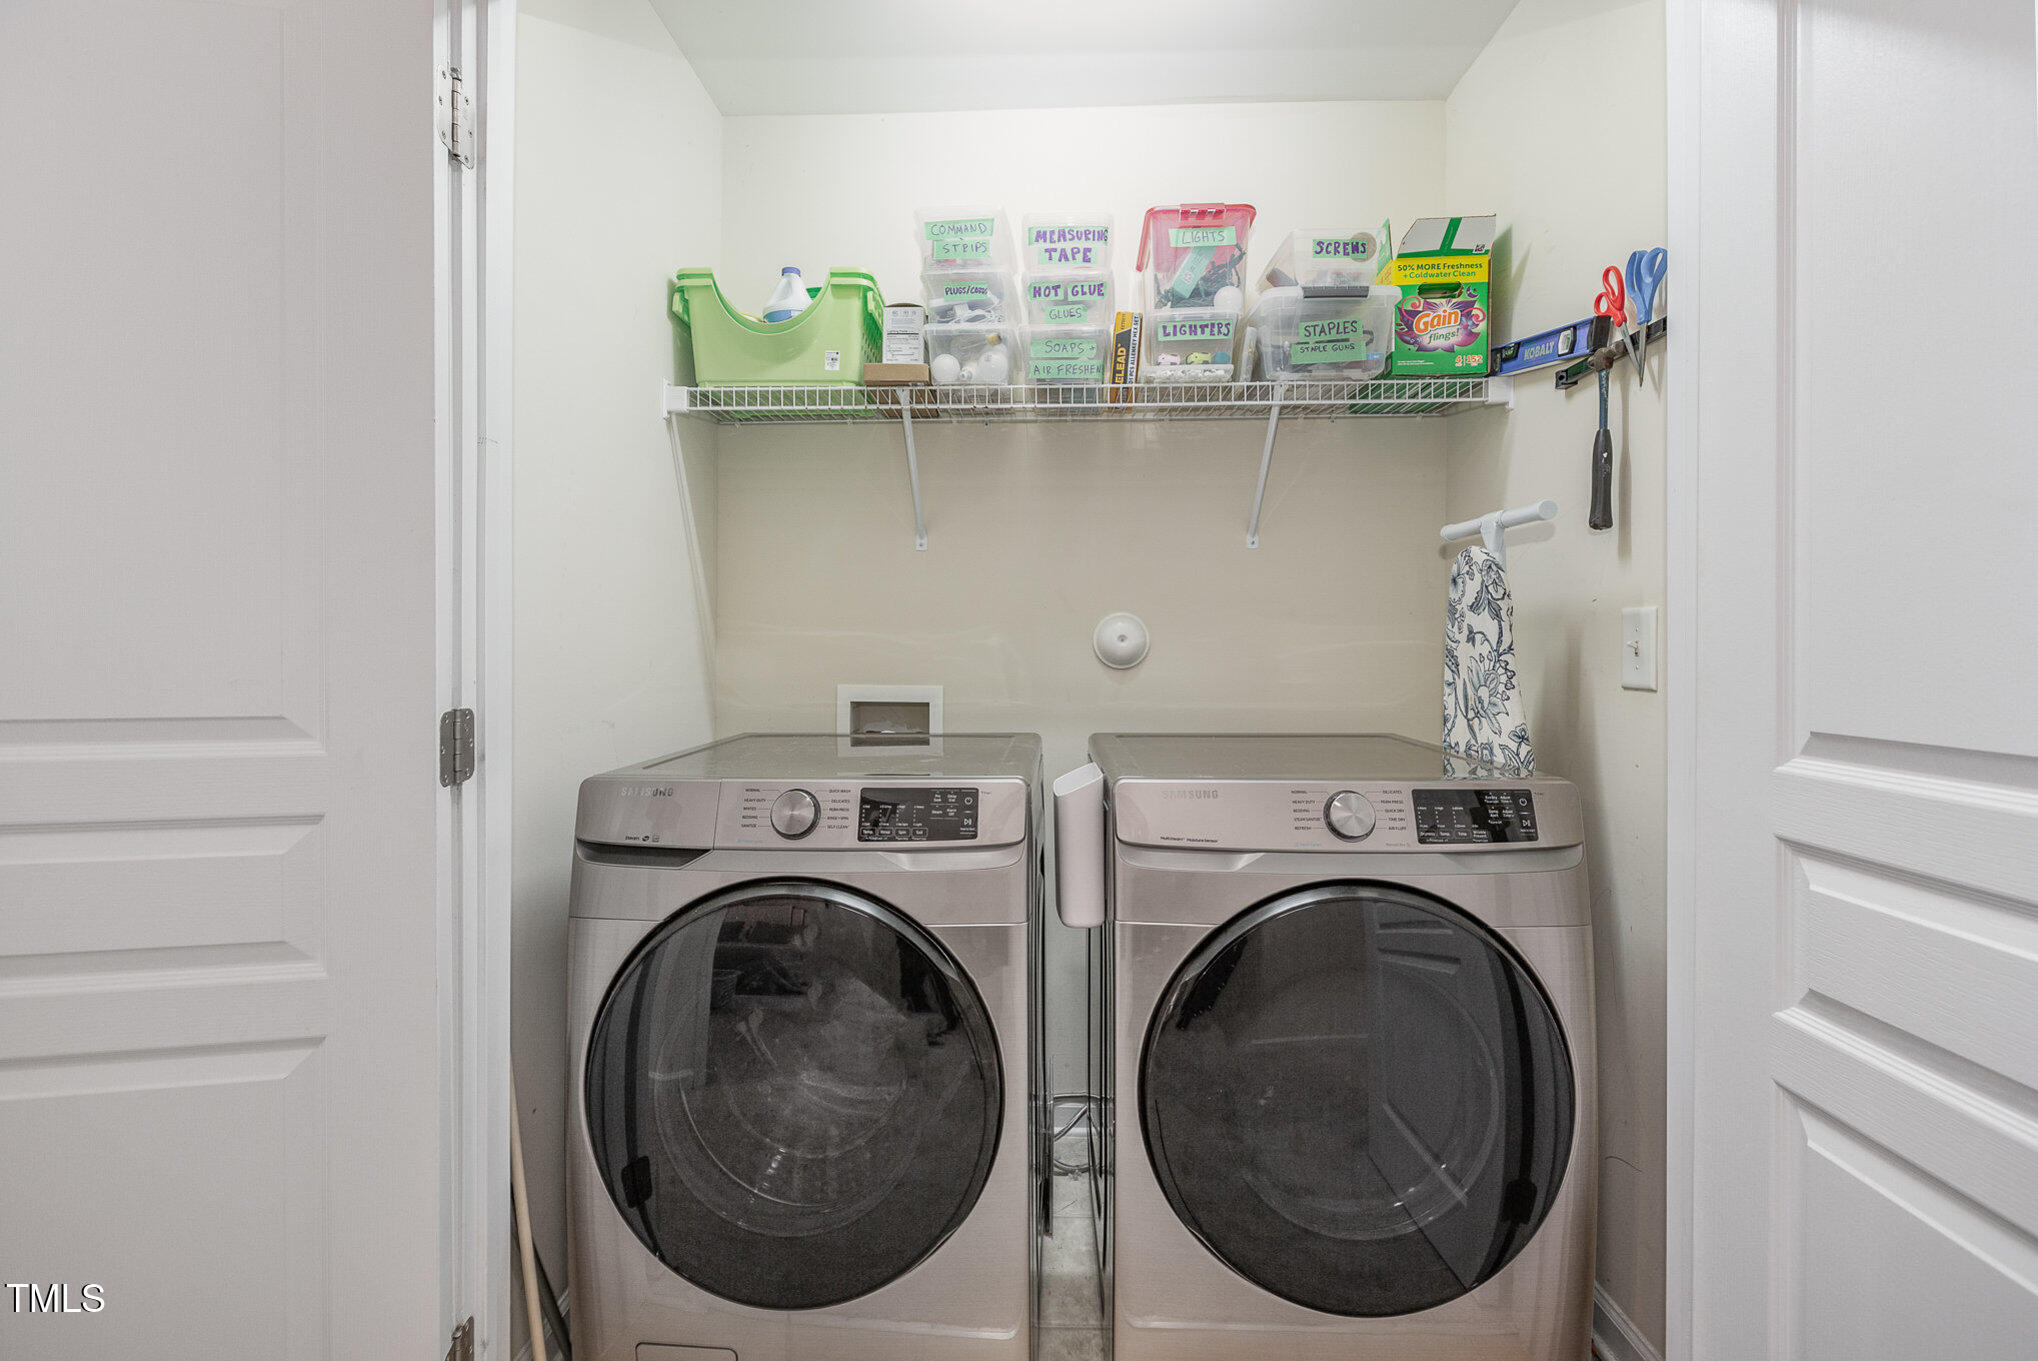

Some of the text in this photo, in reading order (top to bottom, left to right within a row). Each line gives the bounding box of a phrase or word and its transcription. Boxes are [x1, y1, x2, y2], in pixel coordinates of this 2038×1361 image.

[930, 222, 987, 236] COMMAND
[1034, 229, 1108, 243] MEASURING
[1182, 230, 1225, 244] LIGHTS
[942, 240, 987, 254] STRIPS
[1314, 241, 1367, 256] SCREWS
[1044, 247, 1092, 262] TAPE
[1398, 262, 1483, 272] 50% MORE Freshness
[1409, 271, 1451, 279] Coldwater
[1032, 283, 1105, 298] HOT GLUE
[1049, 307, 1082, 320] GLUES
[1414, 309, 1461, 334] Gain
[1161, 322, 1231, 337] LIGHTERS
[1303, 320, 1359, 338] STAPLES
[1427, 328, 1460, 344] flings!
[1045, 341, 1085, 354] SOAPS
[1299, 343, 1355, 354] STAPLE GUNS
[1523, 341, 1555, 360] KOBALT
[1455, 355, 1462, 363] 4
[1466, 355, 1483, 363] 152
[1033, 365, 1051, 376] AIR
[1162, 789, 1219, 799] SAMSUNG
